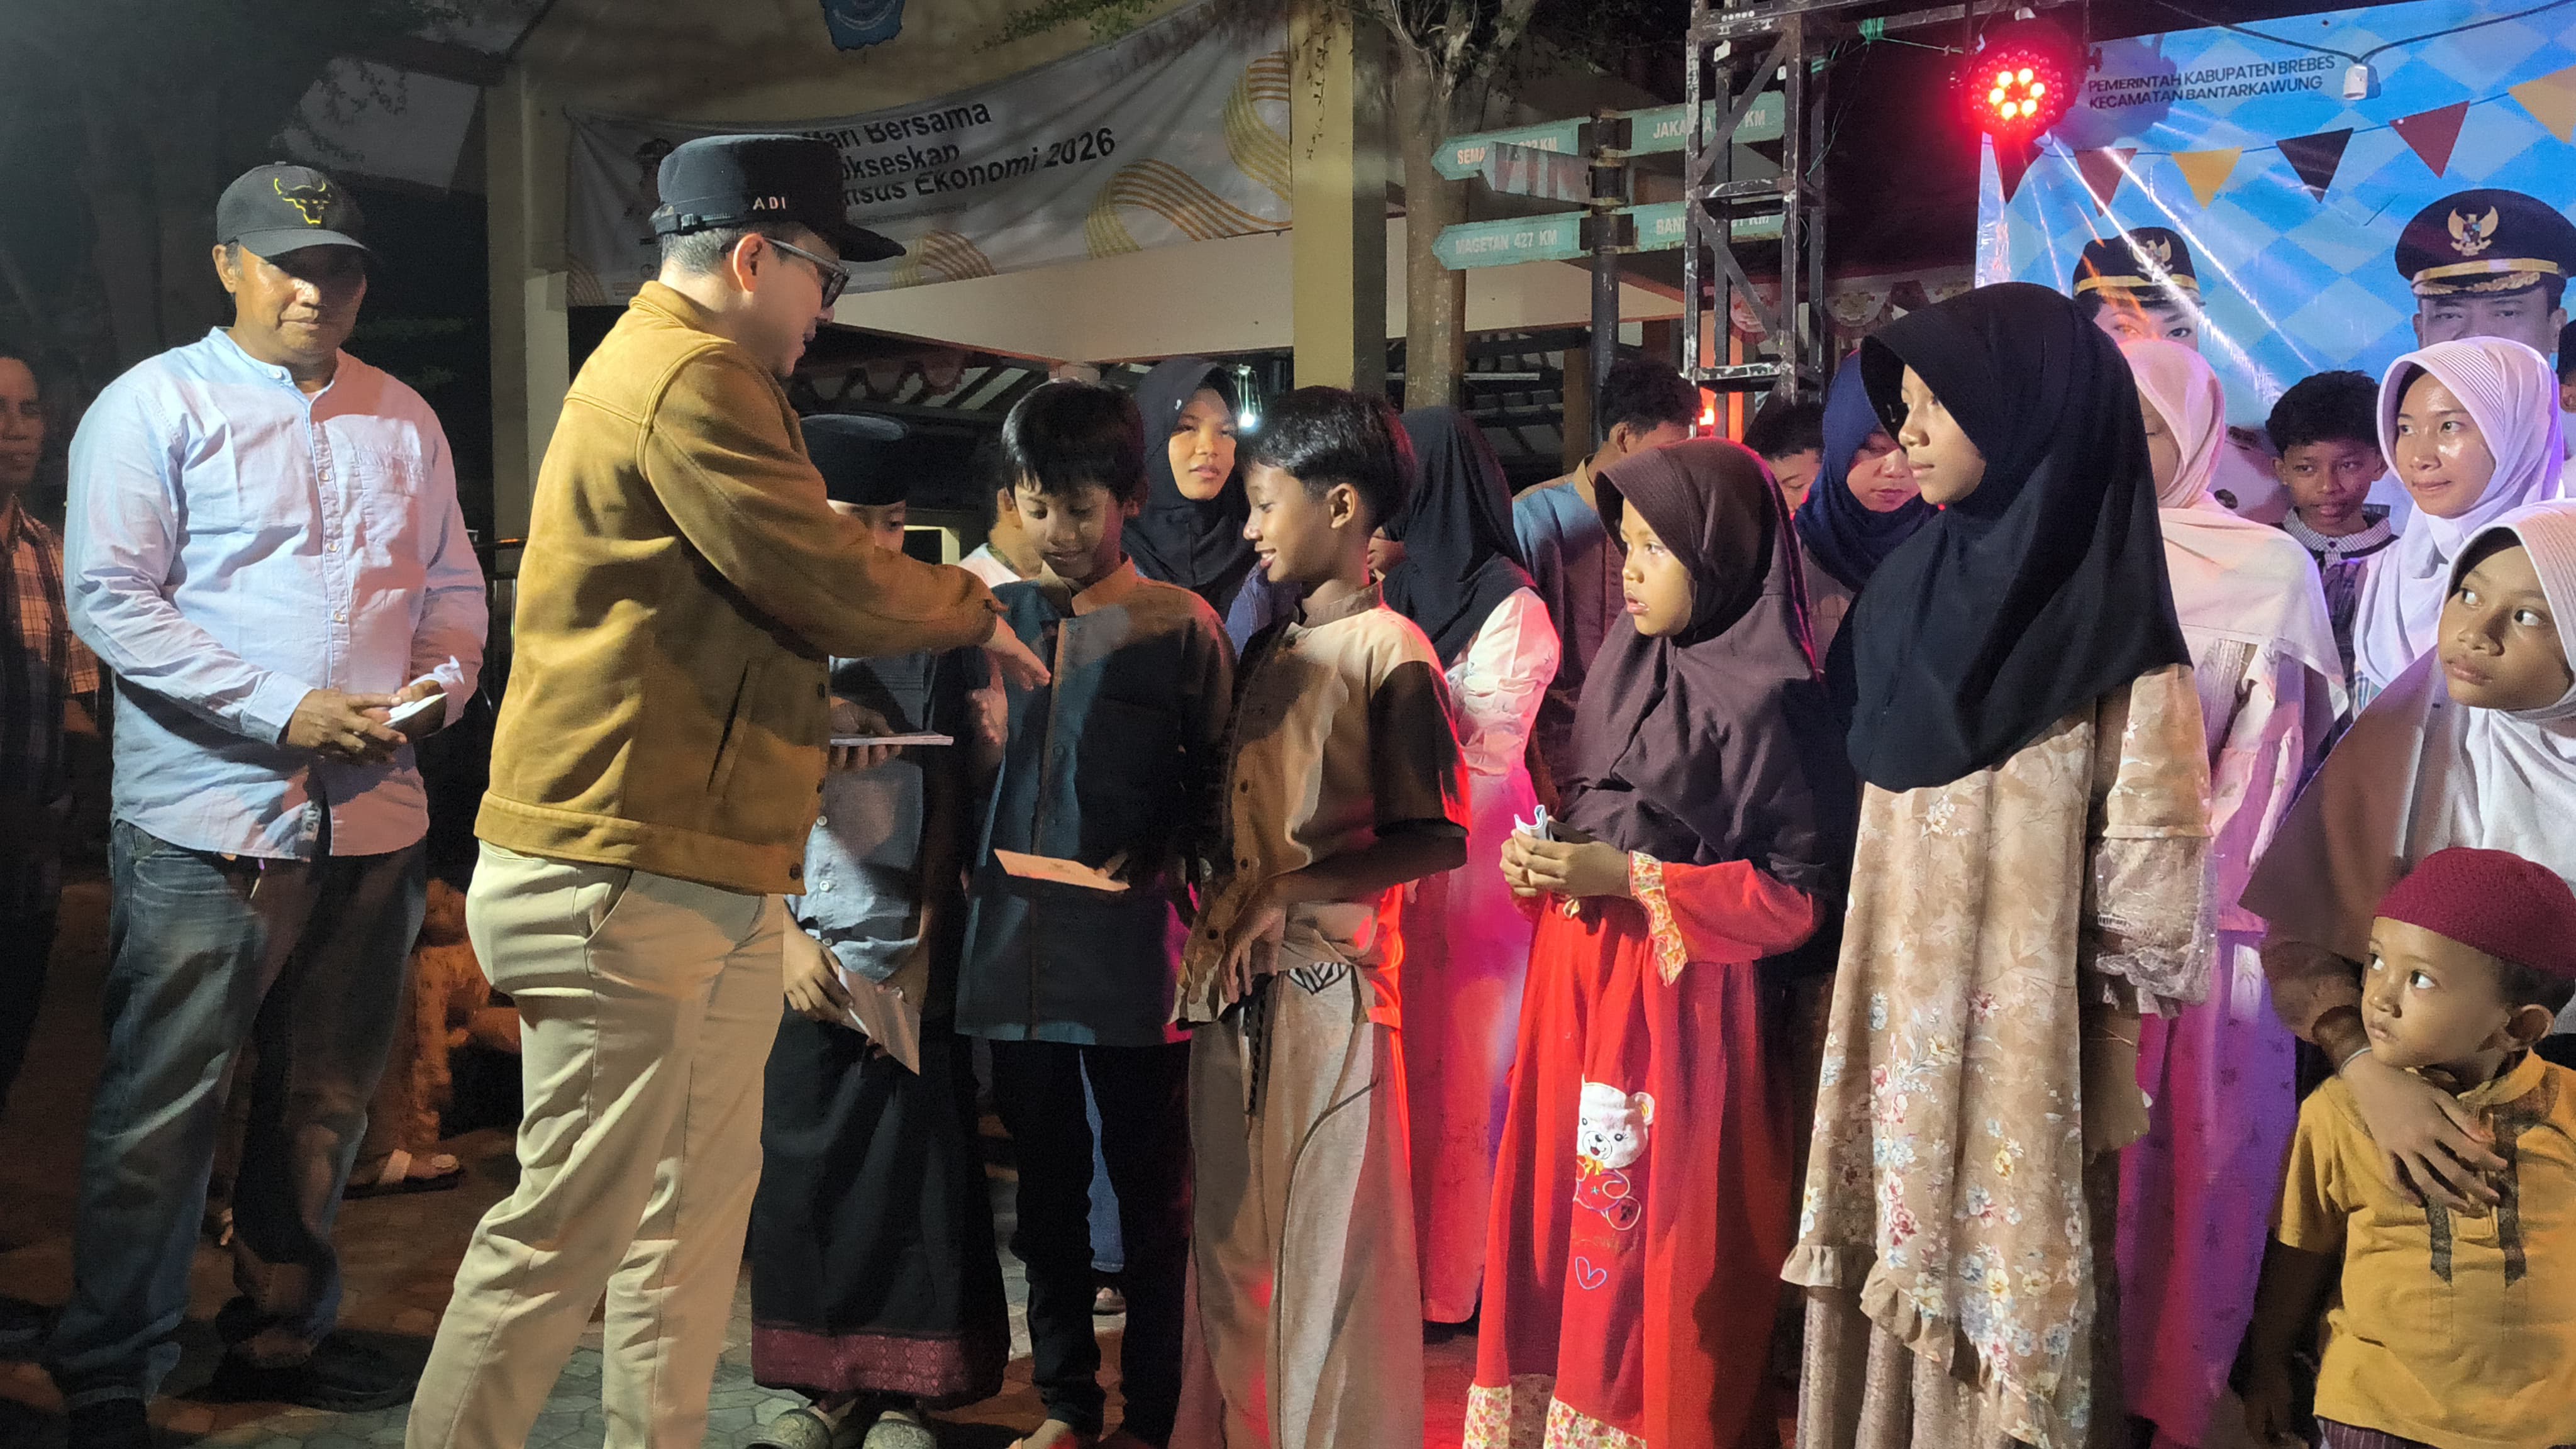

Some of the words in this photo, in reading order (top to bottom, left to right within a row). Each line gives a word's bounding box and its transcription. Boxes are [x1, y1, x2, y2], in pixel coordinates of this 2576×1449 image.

[2089, 74, 2181, 92] PEMERINTAH
[2184, 62, 2275, 85] KABUPATEN
[2278, 55, 2335, 75] BREBES
[2089, 90, 2183, 109] KECAMATAN
[2186, 75, 2323, 100] BANTARKAWUNG
[863, 103, 991, 144] Bersama
[1653, 116, 1713, 139] JAKAA
[1745, 109, 1766, 128] KM
[1540, 136, 1558, 152] KM
[843, 144, 960, 180] kseskan
[845, 182, 907, 206] nsus
[914, 147, 1038, 196] Ekonomi
[1043, 128, 1116, 169] 2026
[753, 196, 786, 210] ADI
[1455, 235, 1509, 254] MAGETAN
[1514, 232, 1534, 248] 427
[1540, 230, 1558, 246] KM
